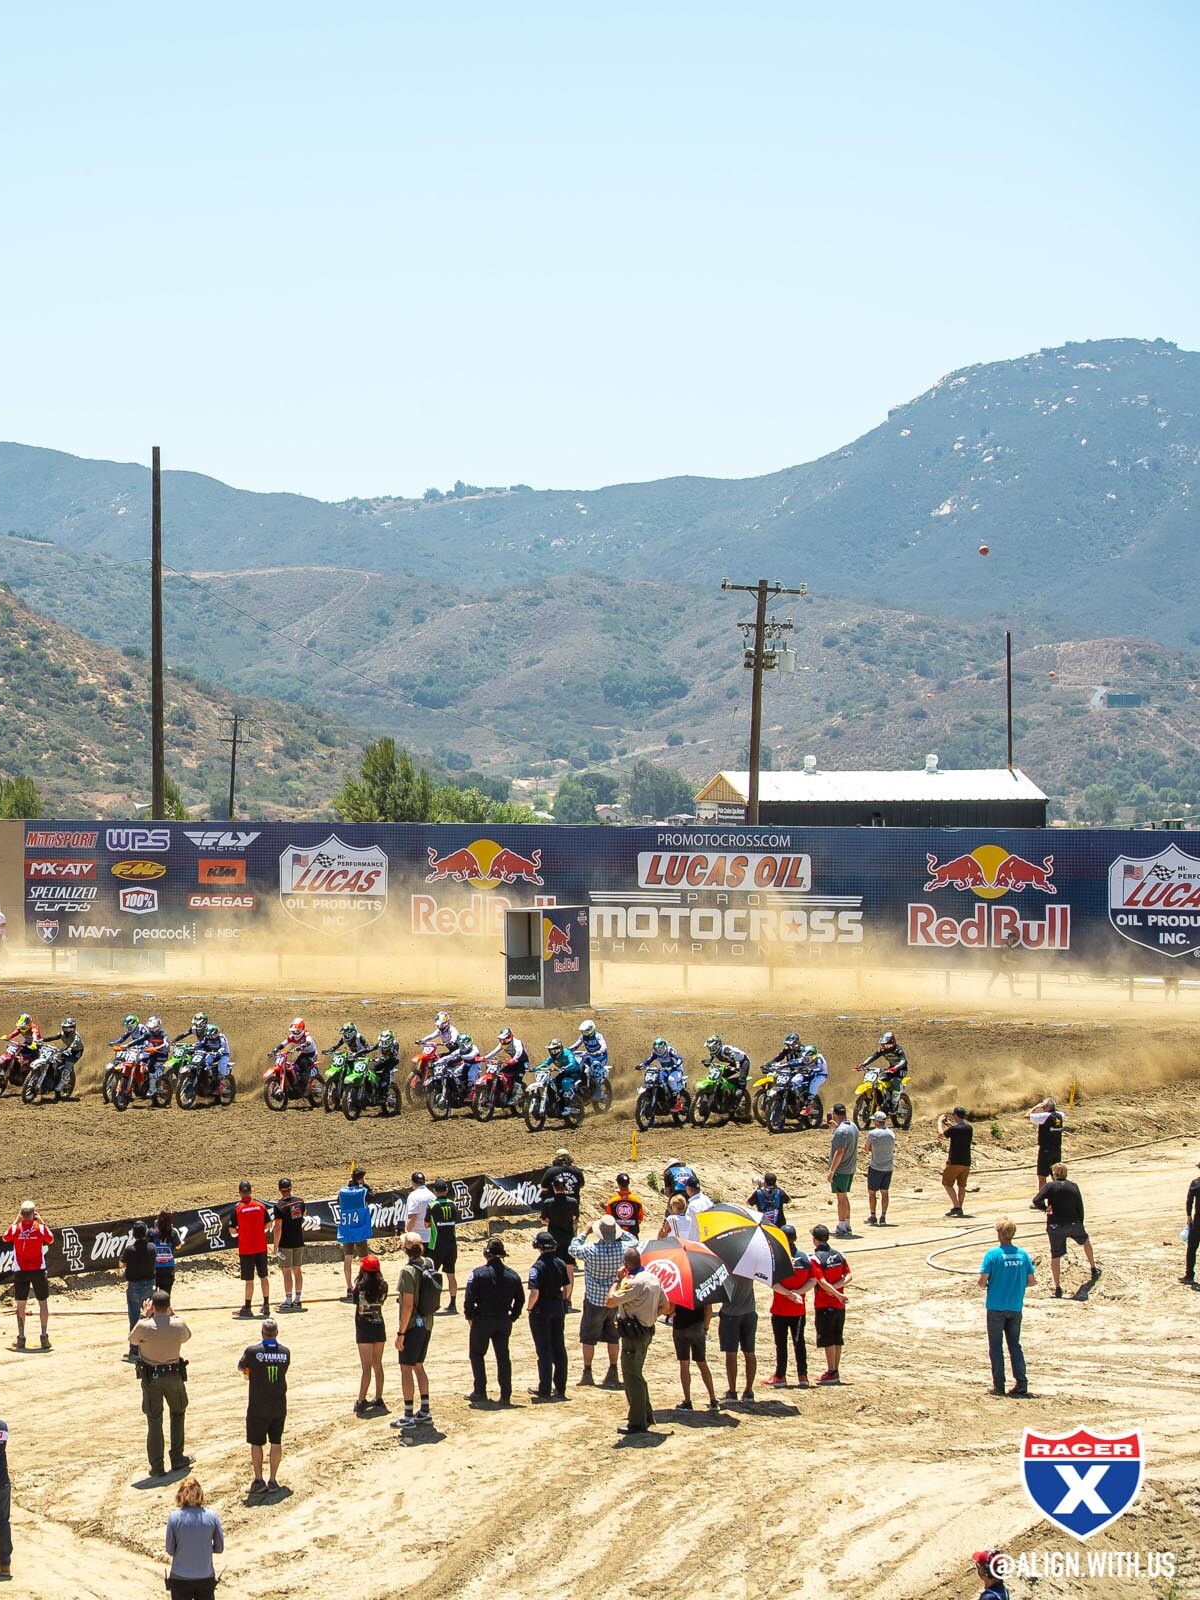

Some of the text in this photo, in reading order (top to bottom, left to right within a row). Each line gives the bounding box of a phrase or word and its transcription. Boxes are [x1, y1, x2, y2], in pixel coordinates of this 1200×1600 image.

[106, 829, 170, 851] WPS
[183, 831, 262, 847] FLY
[657, 833, 791, 847] PROMOTOCROSS.COM
[30, 863, 55, 875] MX
[111, 861, 167, 880] FMF
[207, 865, 236, 877] KTM
[645, 855, 804, 888] LUCAS OIL
[291, 869, 381, 892] LUCAS
[28, 886, 97, 899] SPECIALIZED
[687, 893, 760, 906] PRO
[34, 902, 91, 912] turbo
[125, 893, 153, 908] 100%
[190, 896, 253, 908] GASGAS
[287, 899, 382, 911] OIL PRODUCTS
[412, 894, 482, 935] Red
[1116, 914, 1142, 926] OIL
[589, 906, 864, 943] MOTOCROSS
[908, 903, 1071, 949] Red Bull
[133, 923, 191, 944] peacock
[1159, 933, 1190, 944] INC.
[509, 973, 537, 983] peacock
[332, 1057, 344, 1065] 30
[341, 1211, 359, 1225] 514
